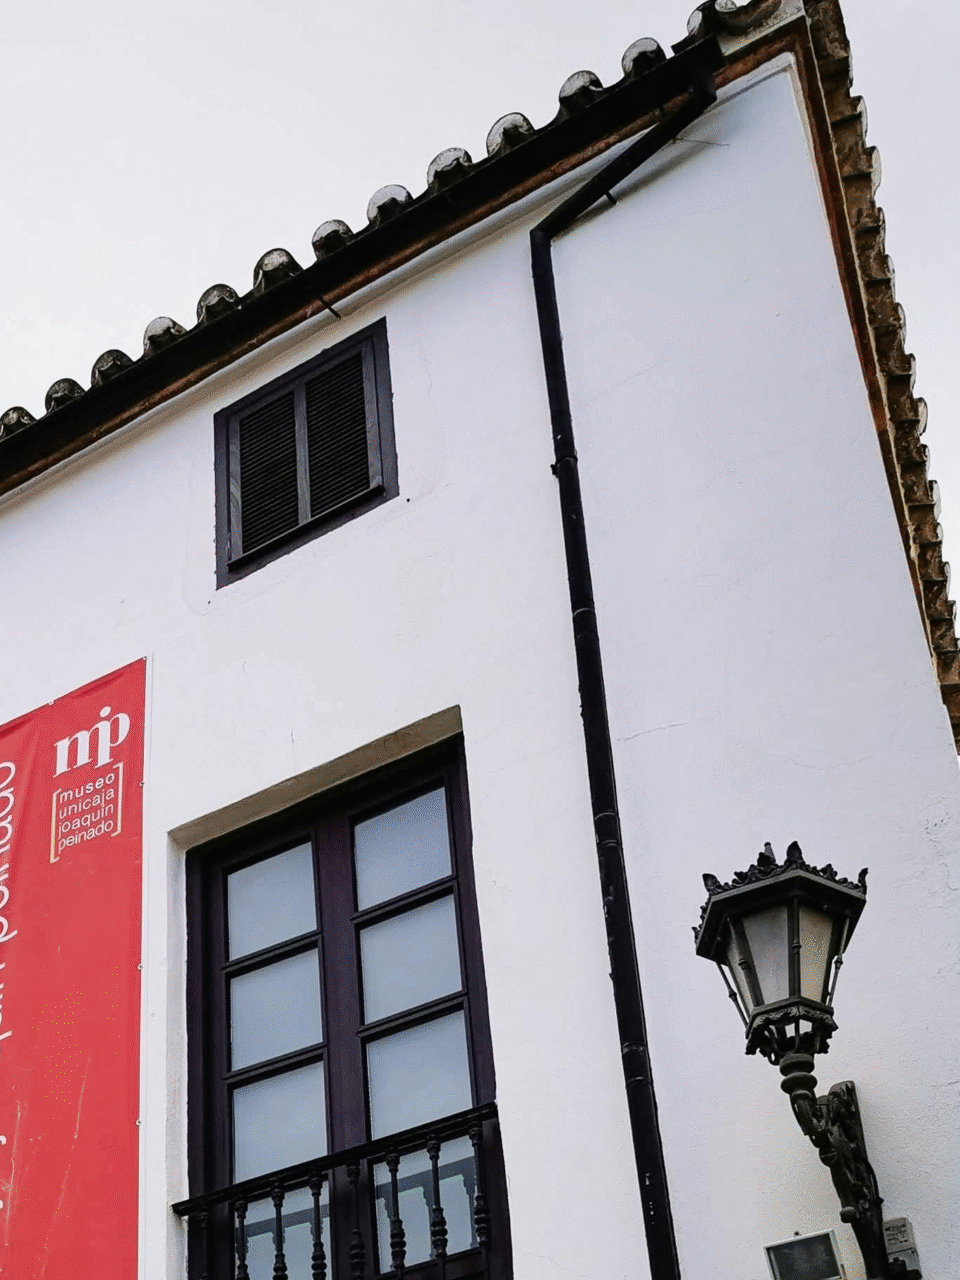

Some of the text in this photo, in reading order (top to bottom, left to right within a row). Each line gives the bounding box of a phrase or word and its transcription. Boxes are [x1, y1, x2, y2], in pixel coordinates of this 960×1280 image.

[59, 773, 115, 803] museo
[59, 788, 115, 819] unicaja
[58, 819, 115, 855] peinado
